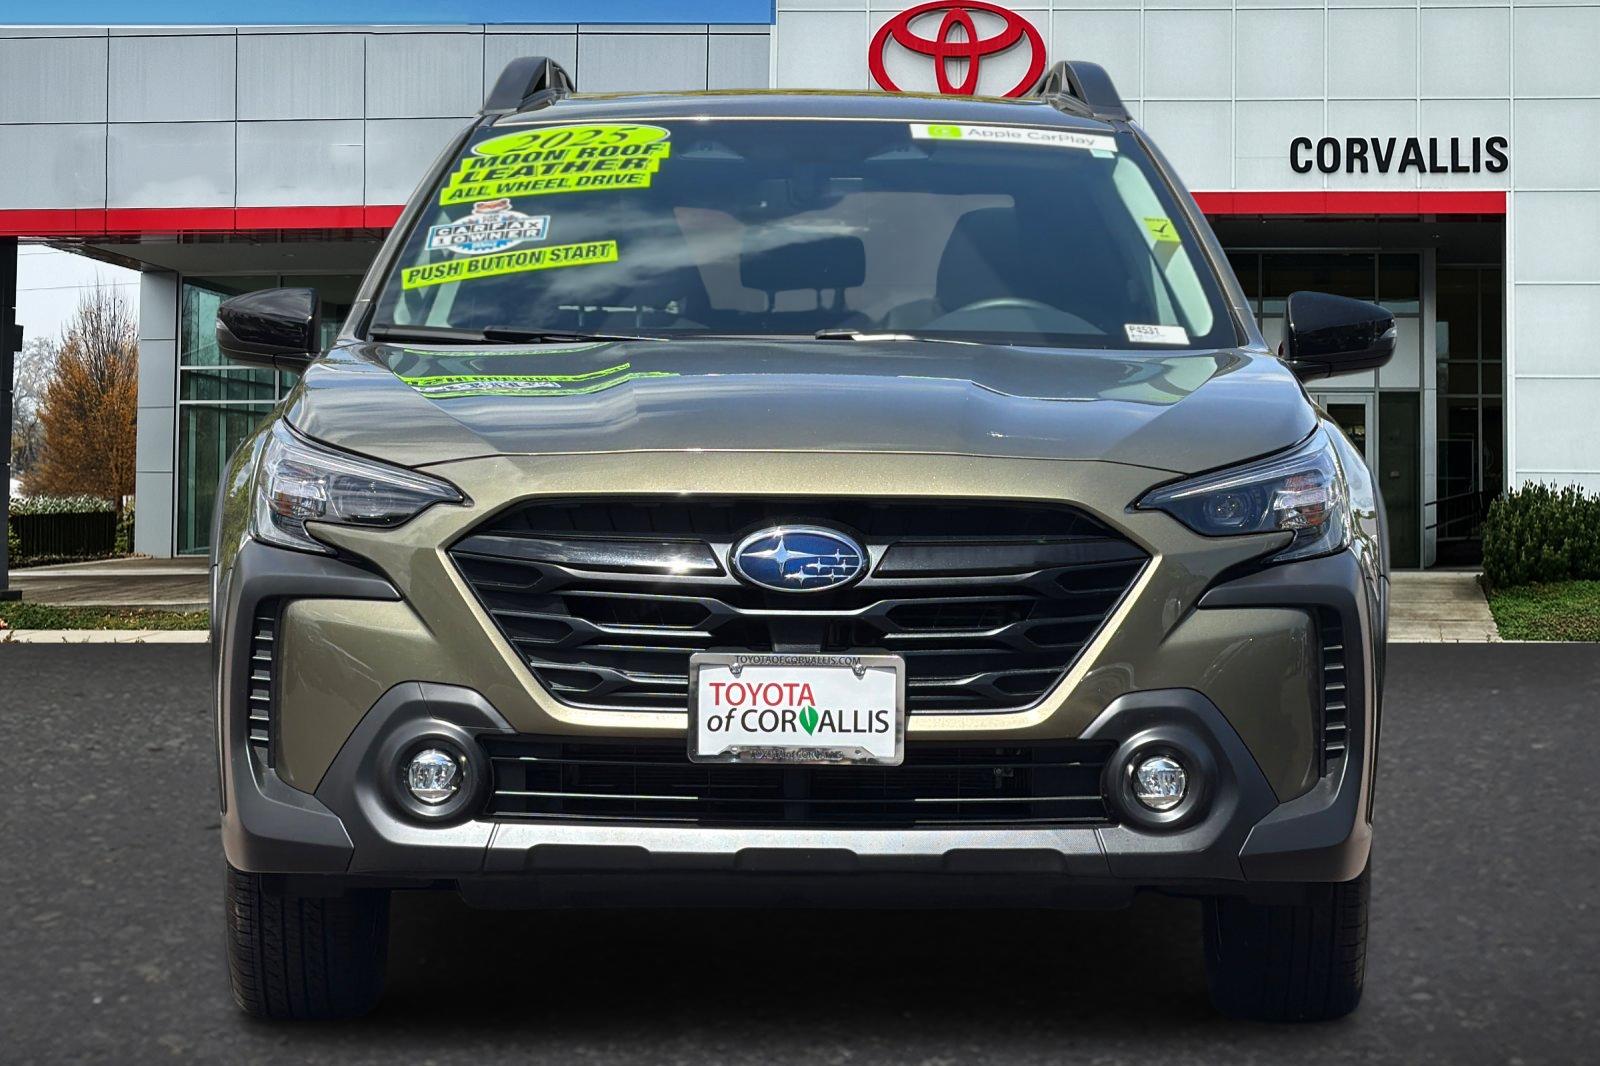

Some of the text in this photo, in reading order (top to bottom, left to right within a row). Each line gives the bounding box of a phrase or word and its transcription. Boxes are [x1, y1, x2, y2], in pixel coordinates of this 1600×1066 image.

[508, 127, 637, 152] 2025
[968, 128, 1096, 146] Apple CarPlay
[469, 142, 662, 170] MOON ROOF
[1289, 136, 1509, 174] CORVALLIS
[459, 157, 651, 184] LEATHER
[448, 173, 646, 200] ALL WHEEL DRIVE
[436, 220, 540, 237] CARFAX
[407, 243, 612, 283] PUSH BUTTON START
[735, 655, 861, 666] TOYOTAOFCORVALLIS.COM
[709, 682, 816, 707] TOYOTA
[707, 707, 737, 732] of
